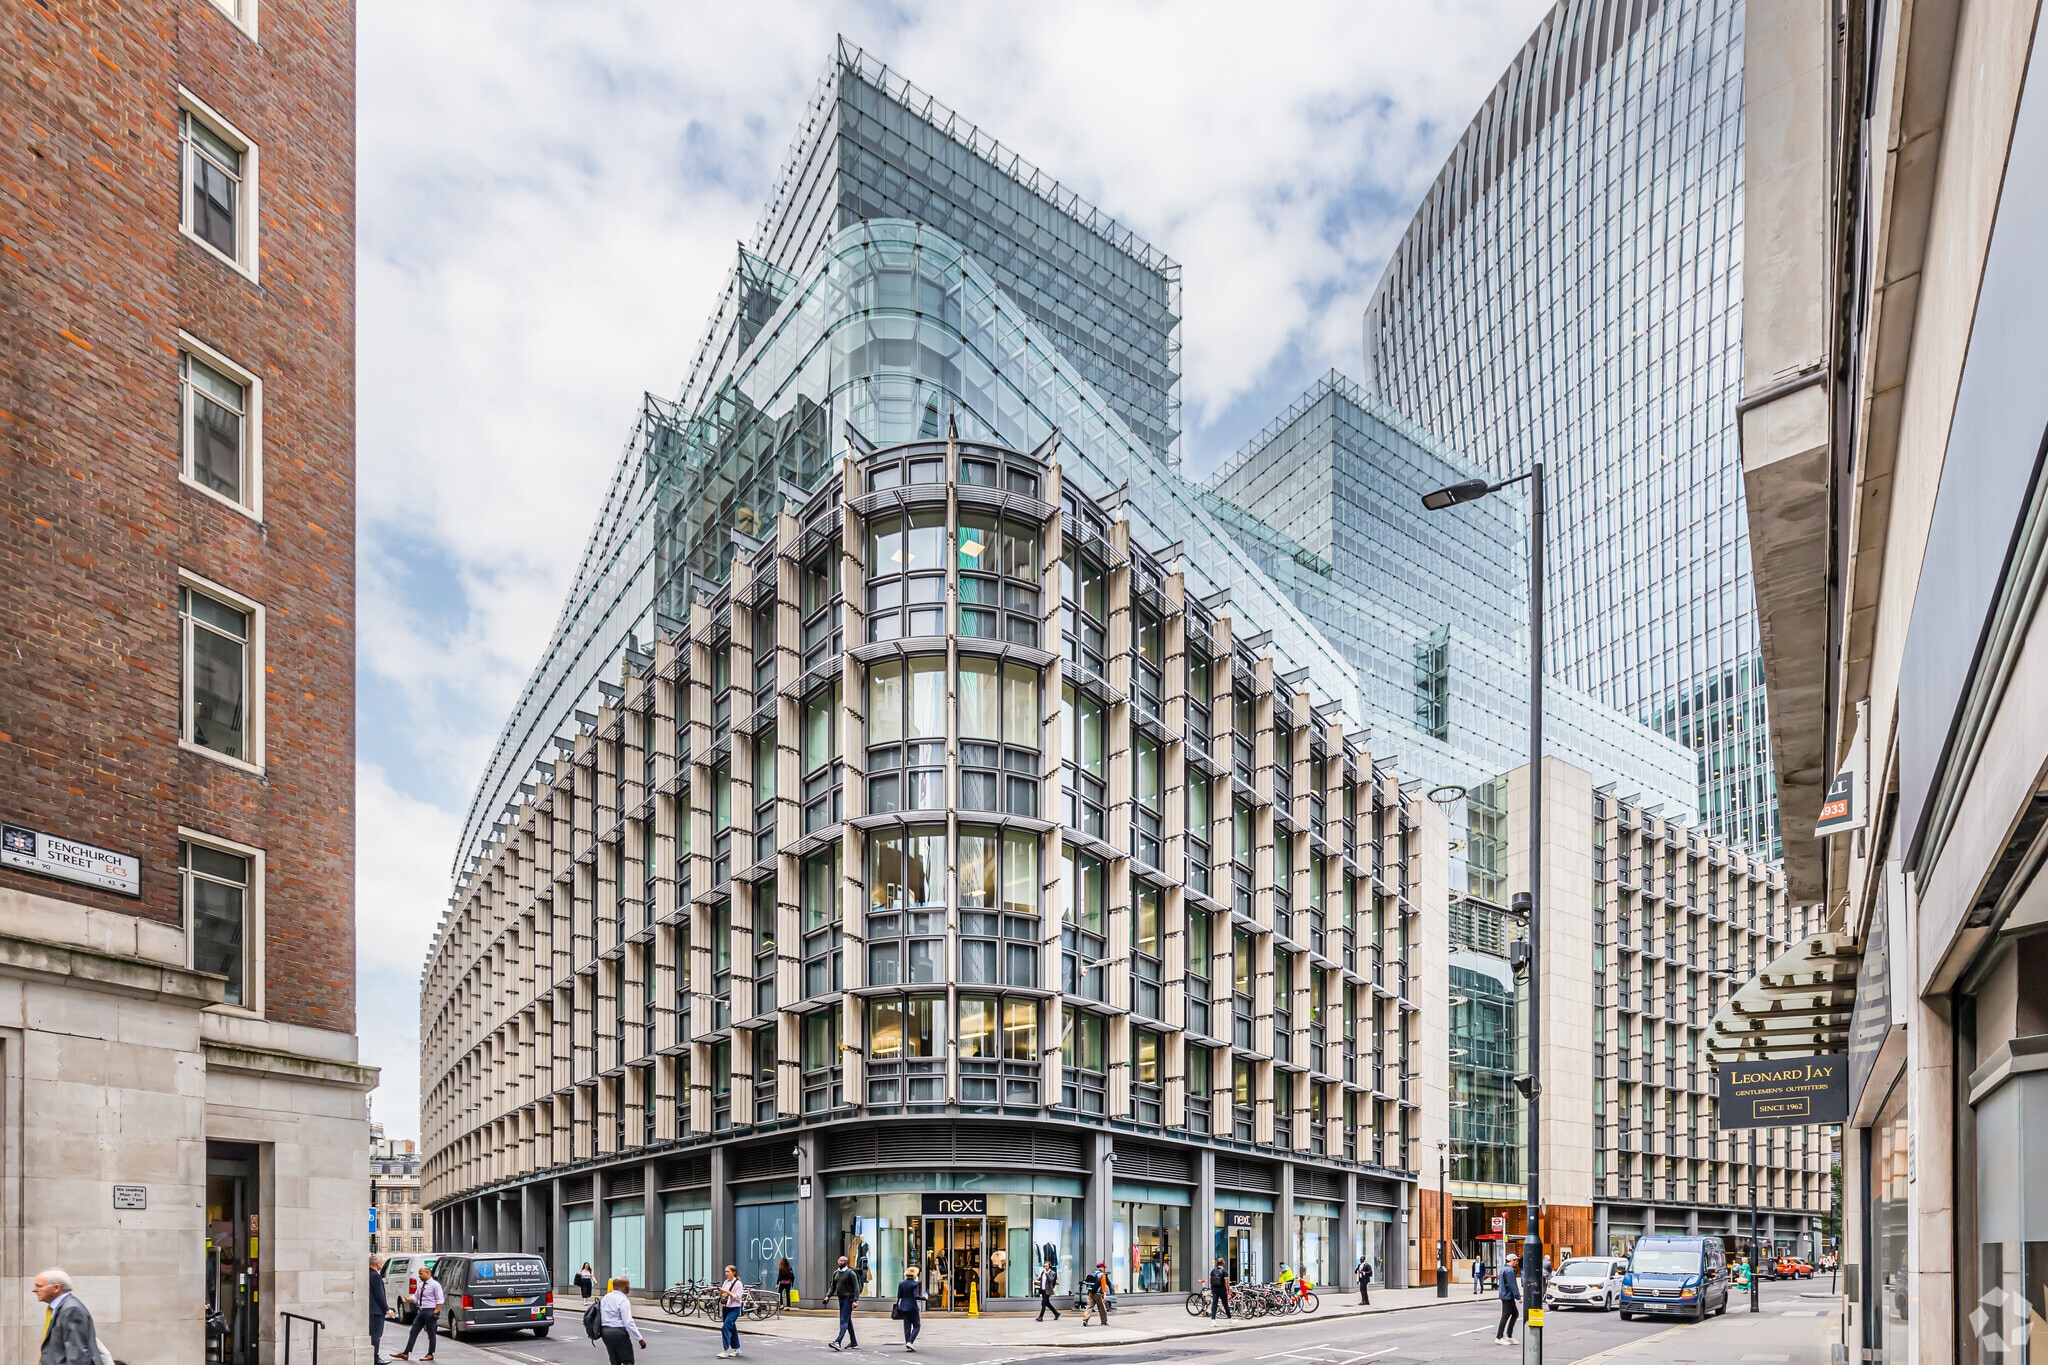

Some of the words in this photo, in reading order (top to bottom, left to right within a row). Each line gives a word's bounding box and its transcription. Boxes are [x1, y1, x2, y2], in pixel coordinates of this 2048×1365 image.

[48, 839, 122, 866] FENCHURCH
[48, 850, 93, 869] STREET
[25, 859, 35, 867] 44
[41, 863, 51, 871] 90
[105, 864, 127, 878] EC3
[1735, 1087, 1783, 1097] GENTLEMEN'S
[1785, 1083, 1829, 1093] OUTFITTERS
[1759, 1104, 1785, 1113] SINCE
[1786, 1103, 1804, 1111] 1962
[939, 1198, 983, 1212] next
[1233, 1215, 1251, 1225] next
[750, 1235, 794, 1260] next
[495, 1262, 539, 1272] Micbex
